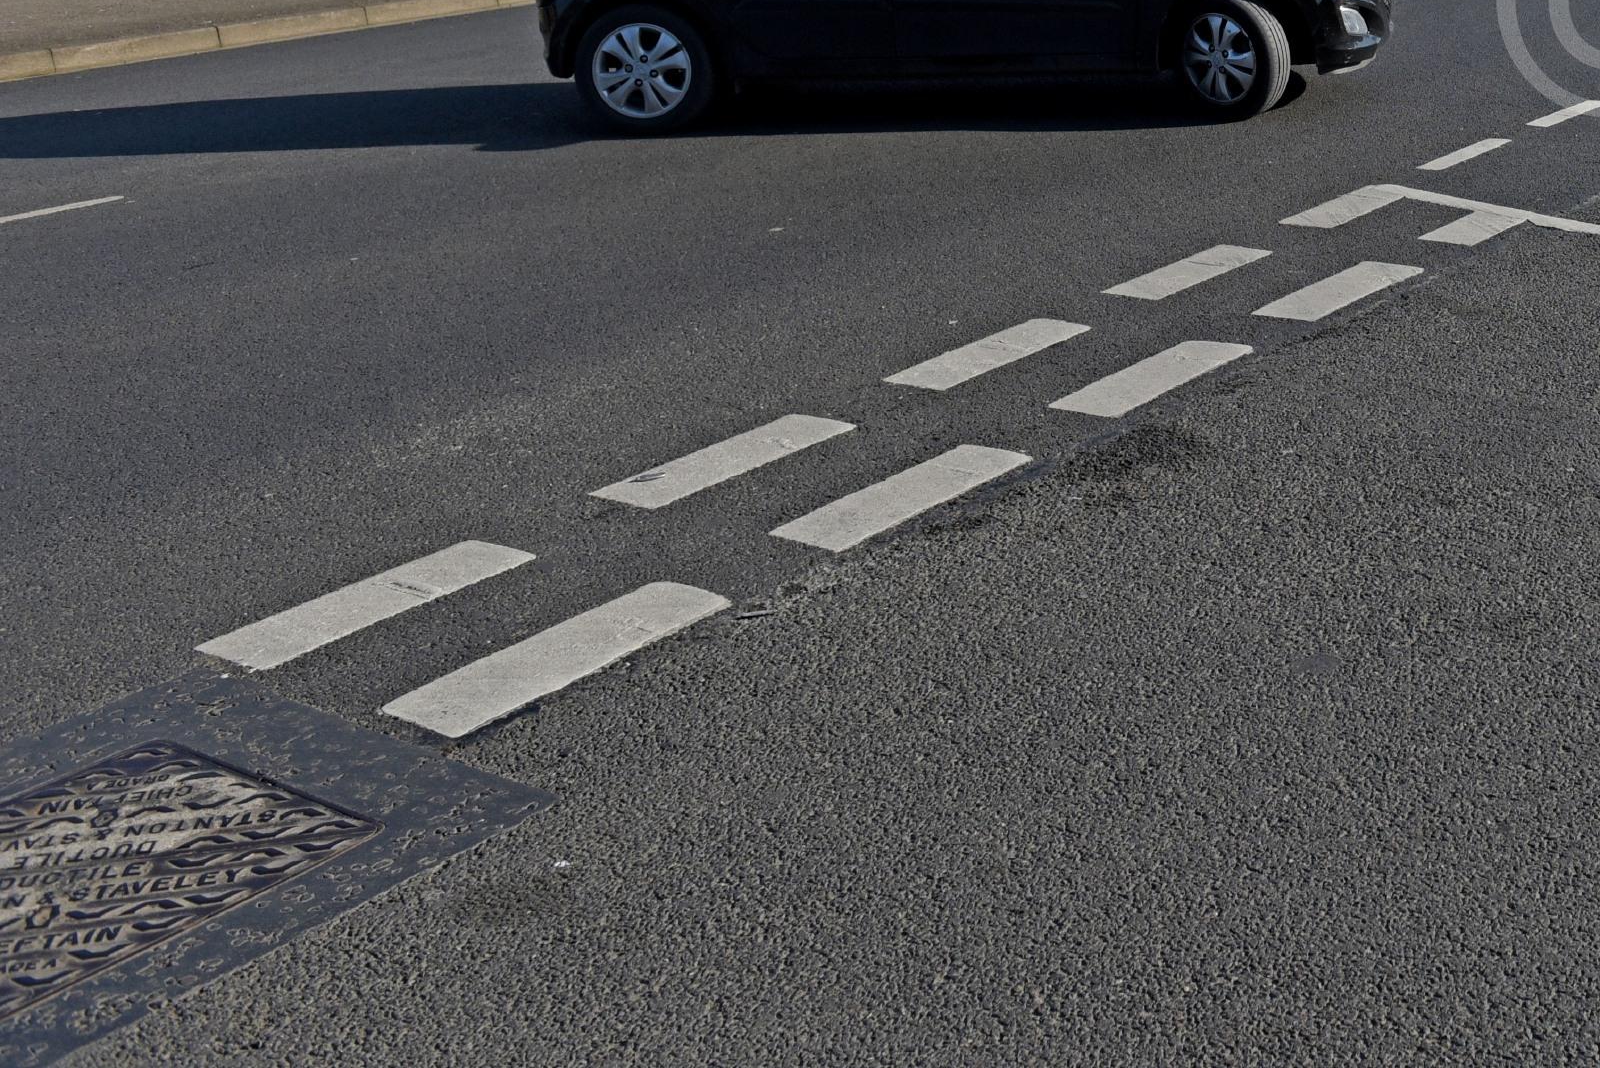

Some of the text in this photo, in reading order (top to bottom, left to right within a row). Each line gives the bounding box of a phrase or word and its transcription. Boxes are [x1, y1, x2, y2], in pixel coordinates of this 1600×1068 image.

[104, 774, 170, 790] GRADE
[97, 828, 113, 841] &
[124, 809, 277, 838] STANTON
[7, 840, 158, 870] DUCTILE
[0, 862, 147, 890] DUCTILE
[36, 891, 55, 905] &
[67, 868, 244, 902] STAVELEY
